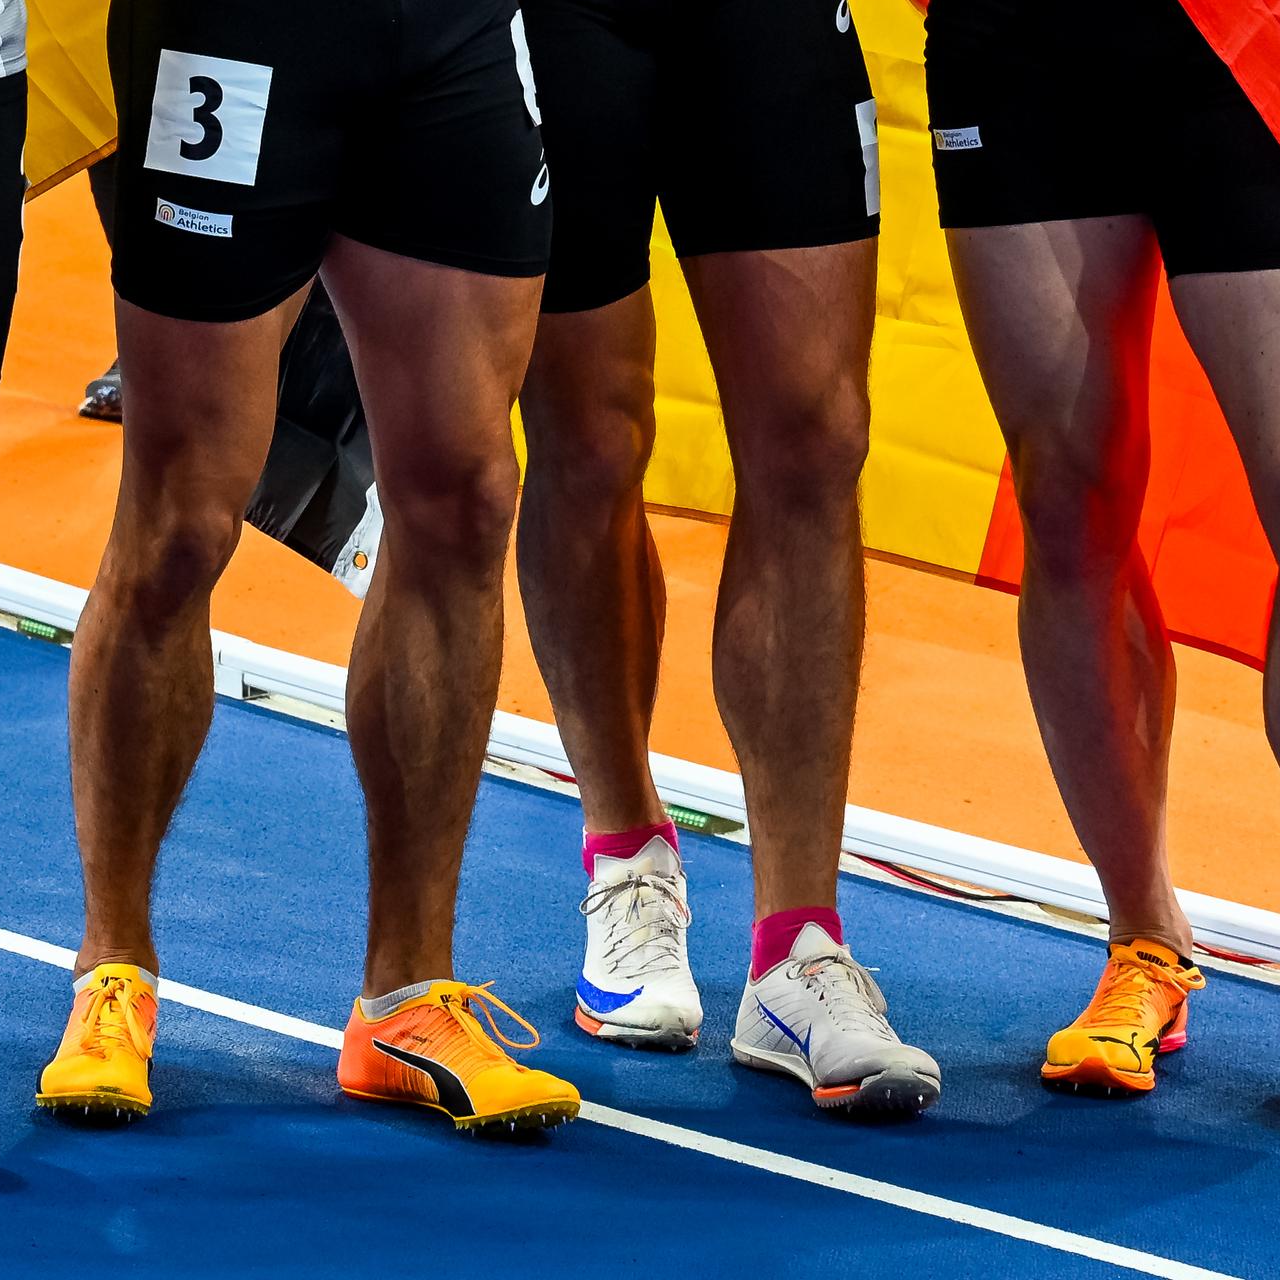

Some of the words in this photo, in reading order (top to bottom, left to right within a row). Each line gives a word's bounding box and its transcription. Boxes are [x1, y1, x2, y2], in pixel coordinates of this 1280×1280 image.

[179, 75, 224, 161] 3
[945, 138, 979, 148] Athletics
[178, 208, 210, 222] Belgian
[176, 217, 229, 235] Athletics
